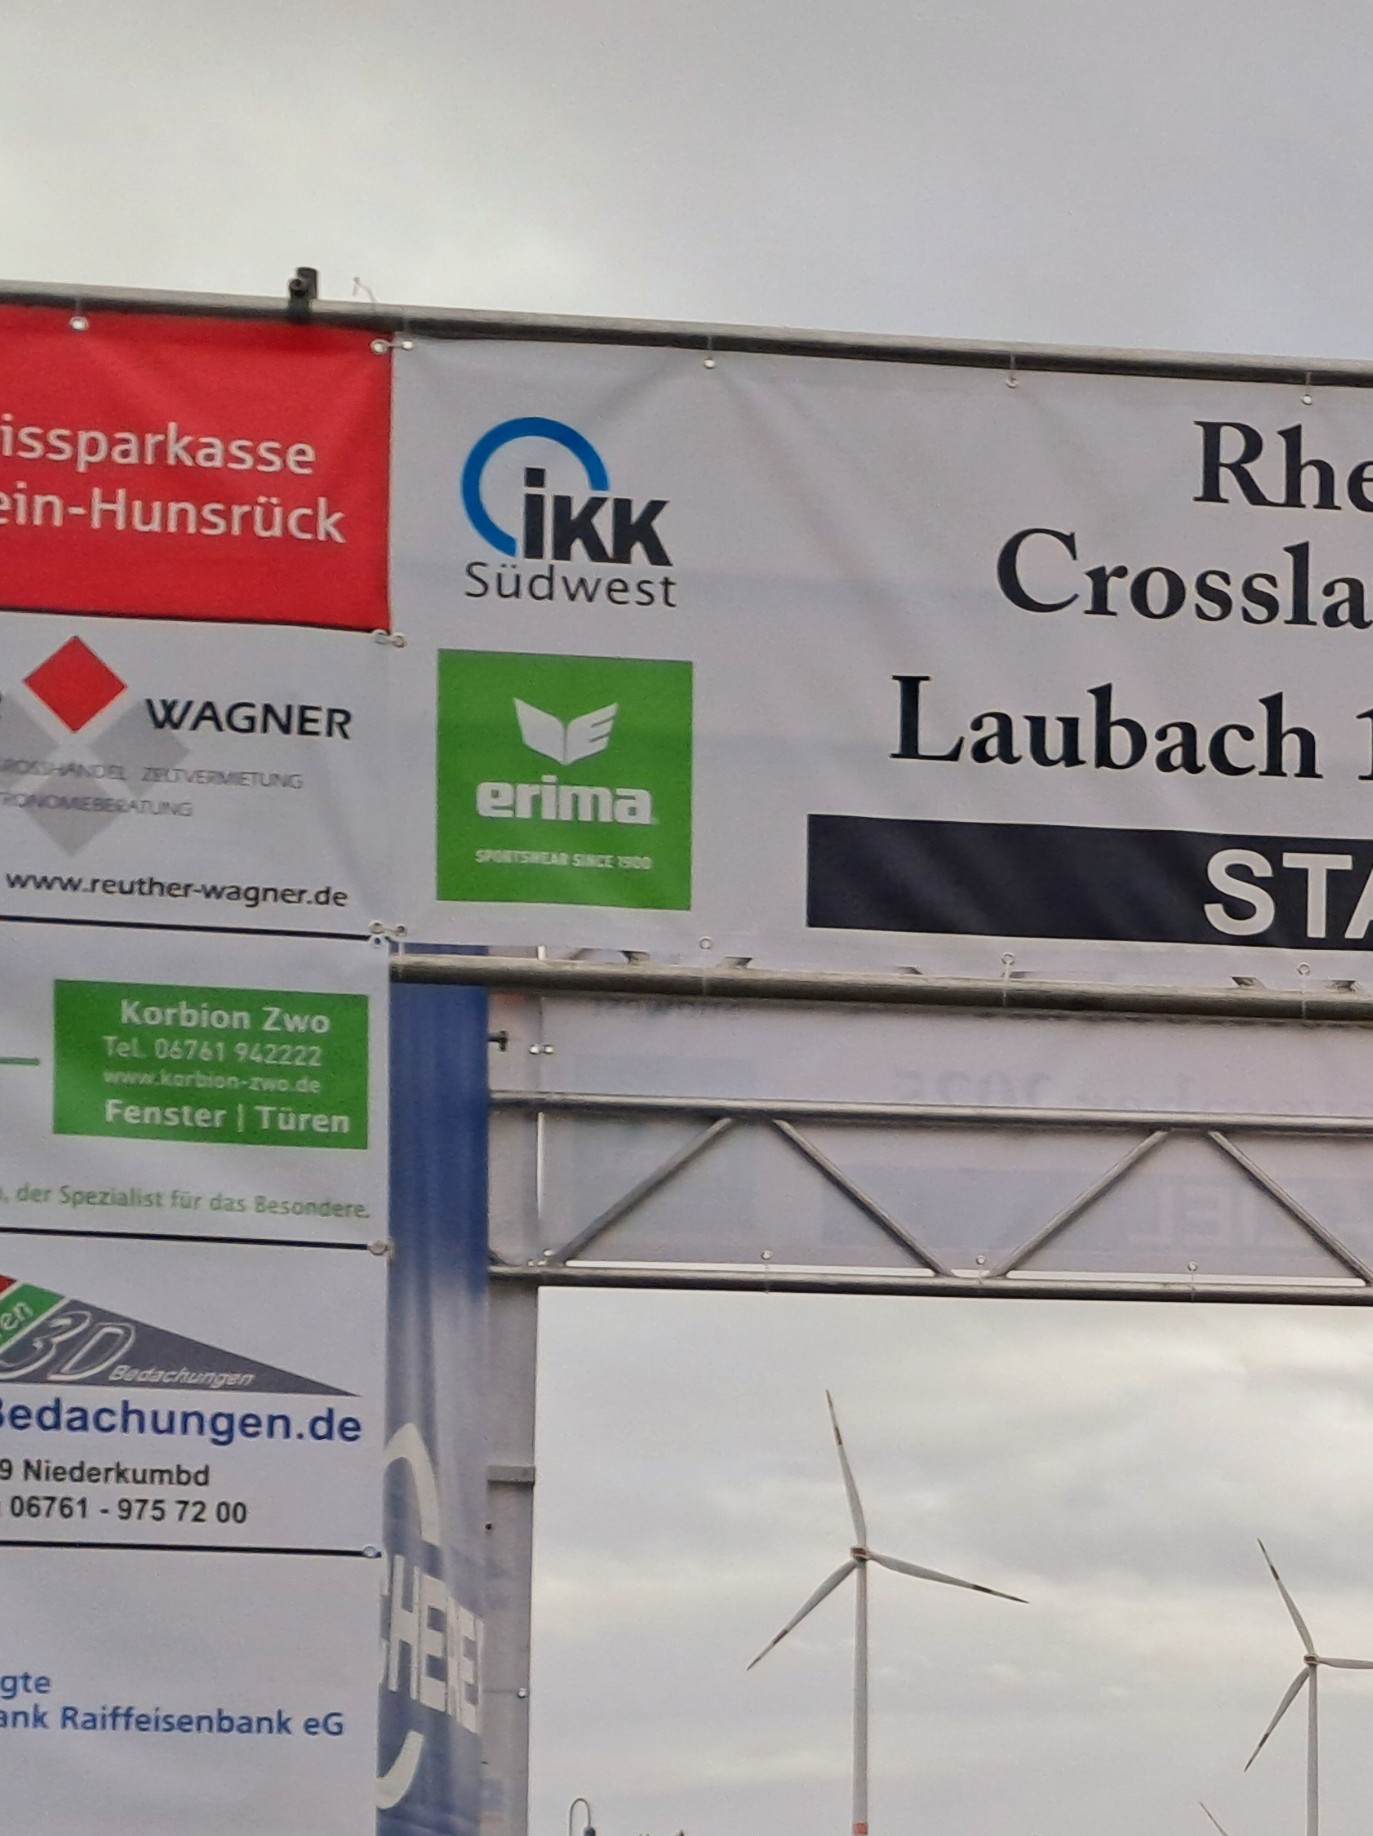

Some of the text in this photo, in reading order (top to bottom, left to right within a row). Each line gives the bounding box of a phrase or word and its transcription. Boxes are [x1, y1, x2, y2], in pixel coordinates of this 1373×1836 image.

[465, 560, 677, 608] Südwest
[145, 698, 352, 740] WAGNER
[890, 674, 1323, 780] Laubach
[476, 776, 653, 826] erima
[475, 848, 570, 869] SPORTSWEAR
[573, 850, 613, 869] SINCE
[6, 872, 348, 908] www.reuther-wagner.de
[121, 999, 330, 1034] Korbion Zwo
[102, 1035, 322, 1067] Tel. 06761 942222
[103, 1069, 321, 1094] www.korbion-zwo.de
[105, 1099, 350, 1134] Fenster Türen
[16, 1184, 51, 1203] der
[60, 1185, 163, 1209] Spezialist
[170, 1189, 201, 1210] für
[210, 1194, 246, 1213] das
[108, 1365, 256, 1388] Bedachungen
[23, 1460, 210, 1487] Niederkumbd
[10, 1496, 88, 1519] 06761
[118, 1499, 165, 1521] 975
[175, 1501, 207, 1523] 72
[216, 1502, 247, 1523] 00
[61, 1705, 293, 1736] Raiffeisenbank
[304, 1711, 345, 1737] eG
